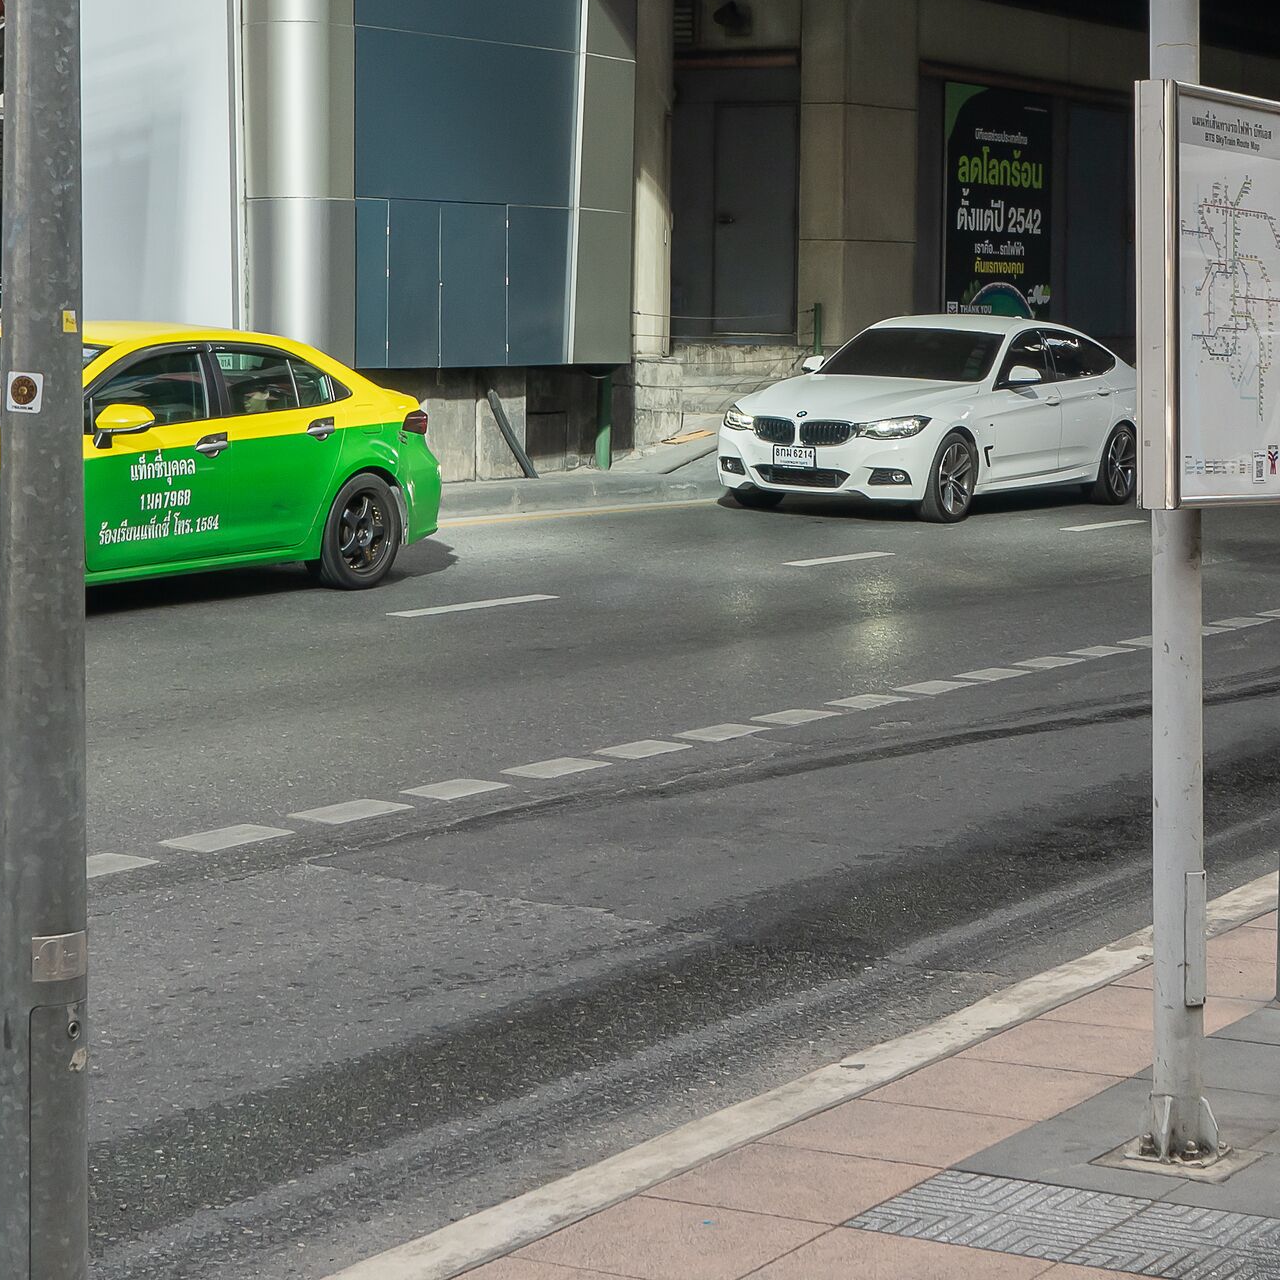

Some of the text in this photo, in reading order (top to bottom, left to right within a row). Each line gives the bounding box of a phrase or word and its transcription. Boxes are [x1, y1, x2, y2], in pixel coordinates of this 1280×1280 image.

[957, 146, 1043, 190] ลดโลกร้อน
[1007, 206, 1042, 235] 2542
[960, 304, 993, 314] THANK YOU
[793, 449, 813, 459] 6214
[163, 489, 192, 509] 7968
[195, 514, 220, 533] 1584
